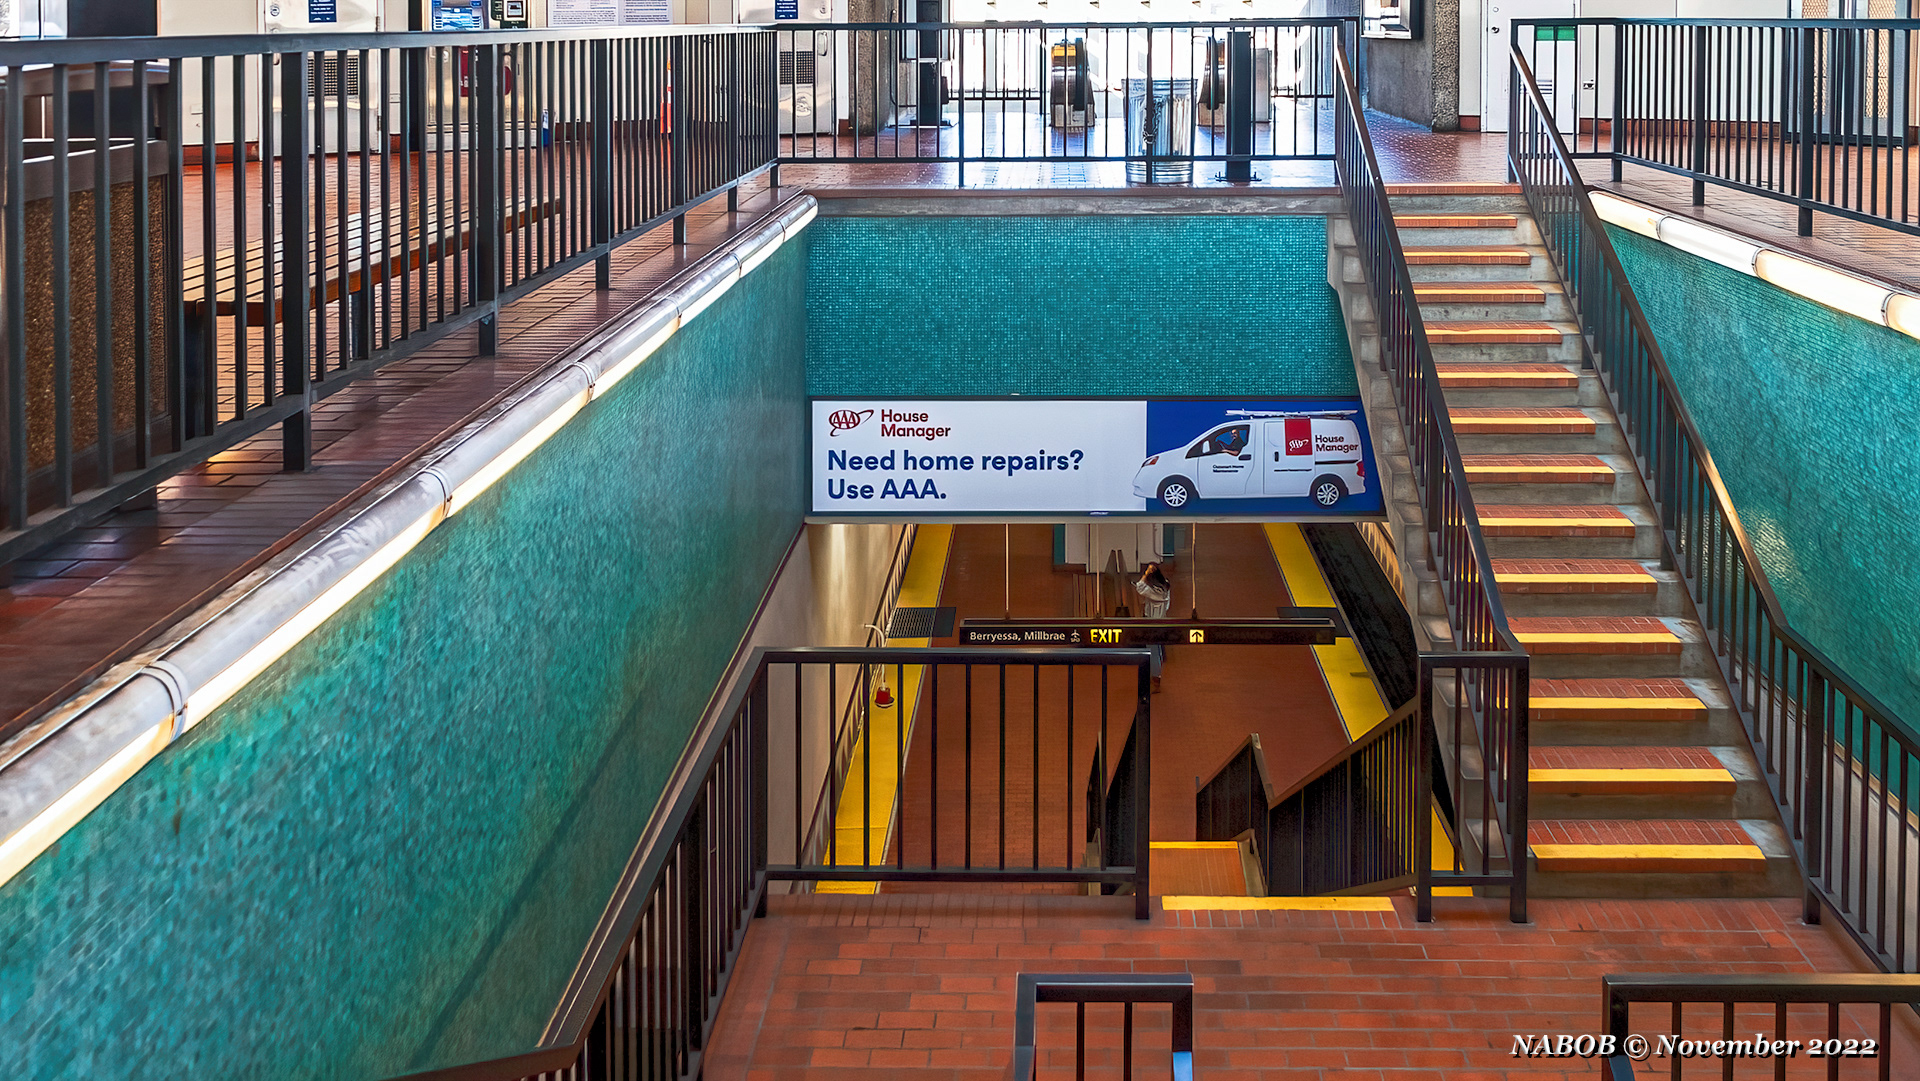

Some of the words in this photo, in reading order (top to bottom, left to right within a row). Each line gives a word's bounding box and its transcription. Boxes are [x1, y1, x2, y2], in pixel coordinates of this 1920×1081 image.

[881, 409, 929, 422] House
[881, 424, 951, 441] Manager
[1315, 434, 1345, 444] House
[1316, 444, 1359, 454] Manager
[828, 450, 895, 470] Need
[903, 450, 974, 470] home
[982, 450, 1084, 476] repairs?
[828, 479, 874, 499] Use
[880, 479, 947, 499] AAA.
[969, 631, 1021, 643] Berryessa,
[1024, 631, 1066, 641] Millbrae
[1090, 629, 1122, 643] EXIT
